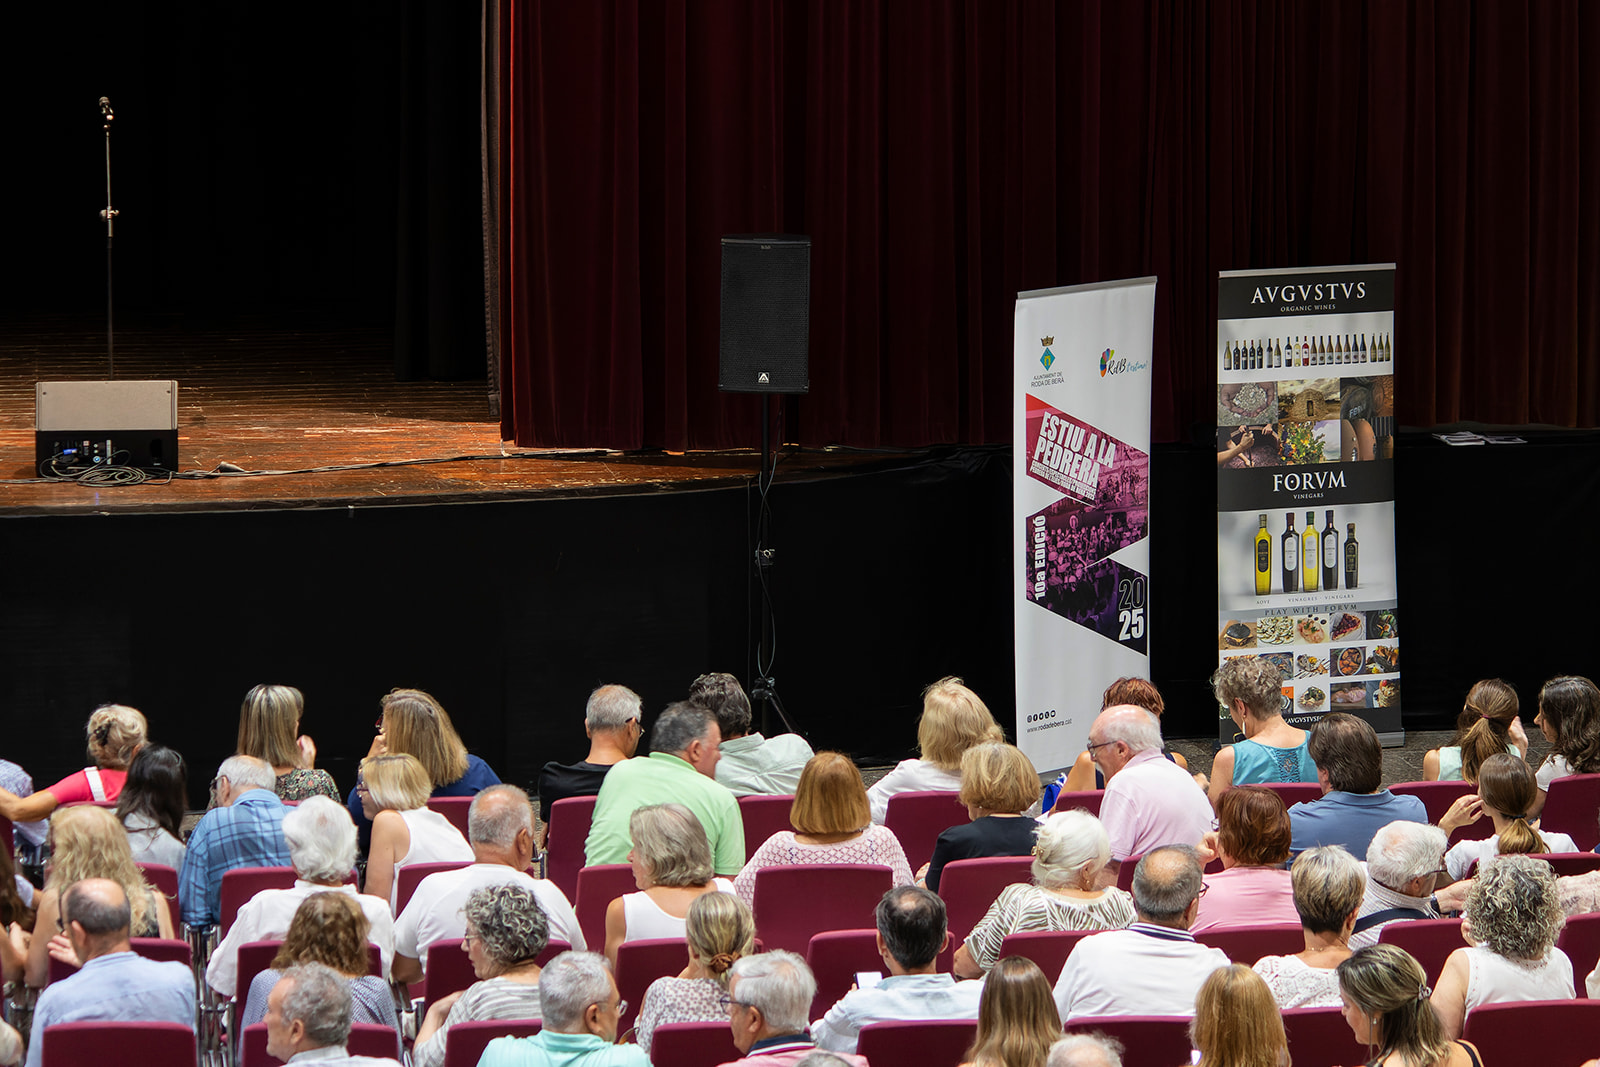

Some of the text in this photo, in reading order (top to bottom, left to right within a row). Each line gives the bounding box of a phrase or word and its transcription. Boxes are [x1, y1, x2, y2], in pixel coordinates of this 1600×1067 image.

[1251, 281, 1367, 305] AVGVSTVS
[1280, 303, 1336, 313] ORGANIC WINES
[1039, 411, 1117, 469] ESTIU A LA
[1033, 435, 1101, 488] PEDRERA
[1272, 470, 1347, 492] FORVM
[1293, 492, 1324, 500] VINEGARS
[1033, 515, 1046, 601] 10a EDICIÓ
[1118, 577, 1145, 611] 20
[1264, 603, 1358, 616] PLAY WITH FORVM
[1118, 608, 1145, 641] 25
